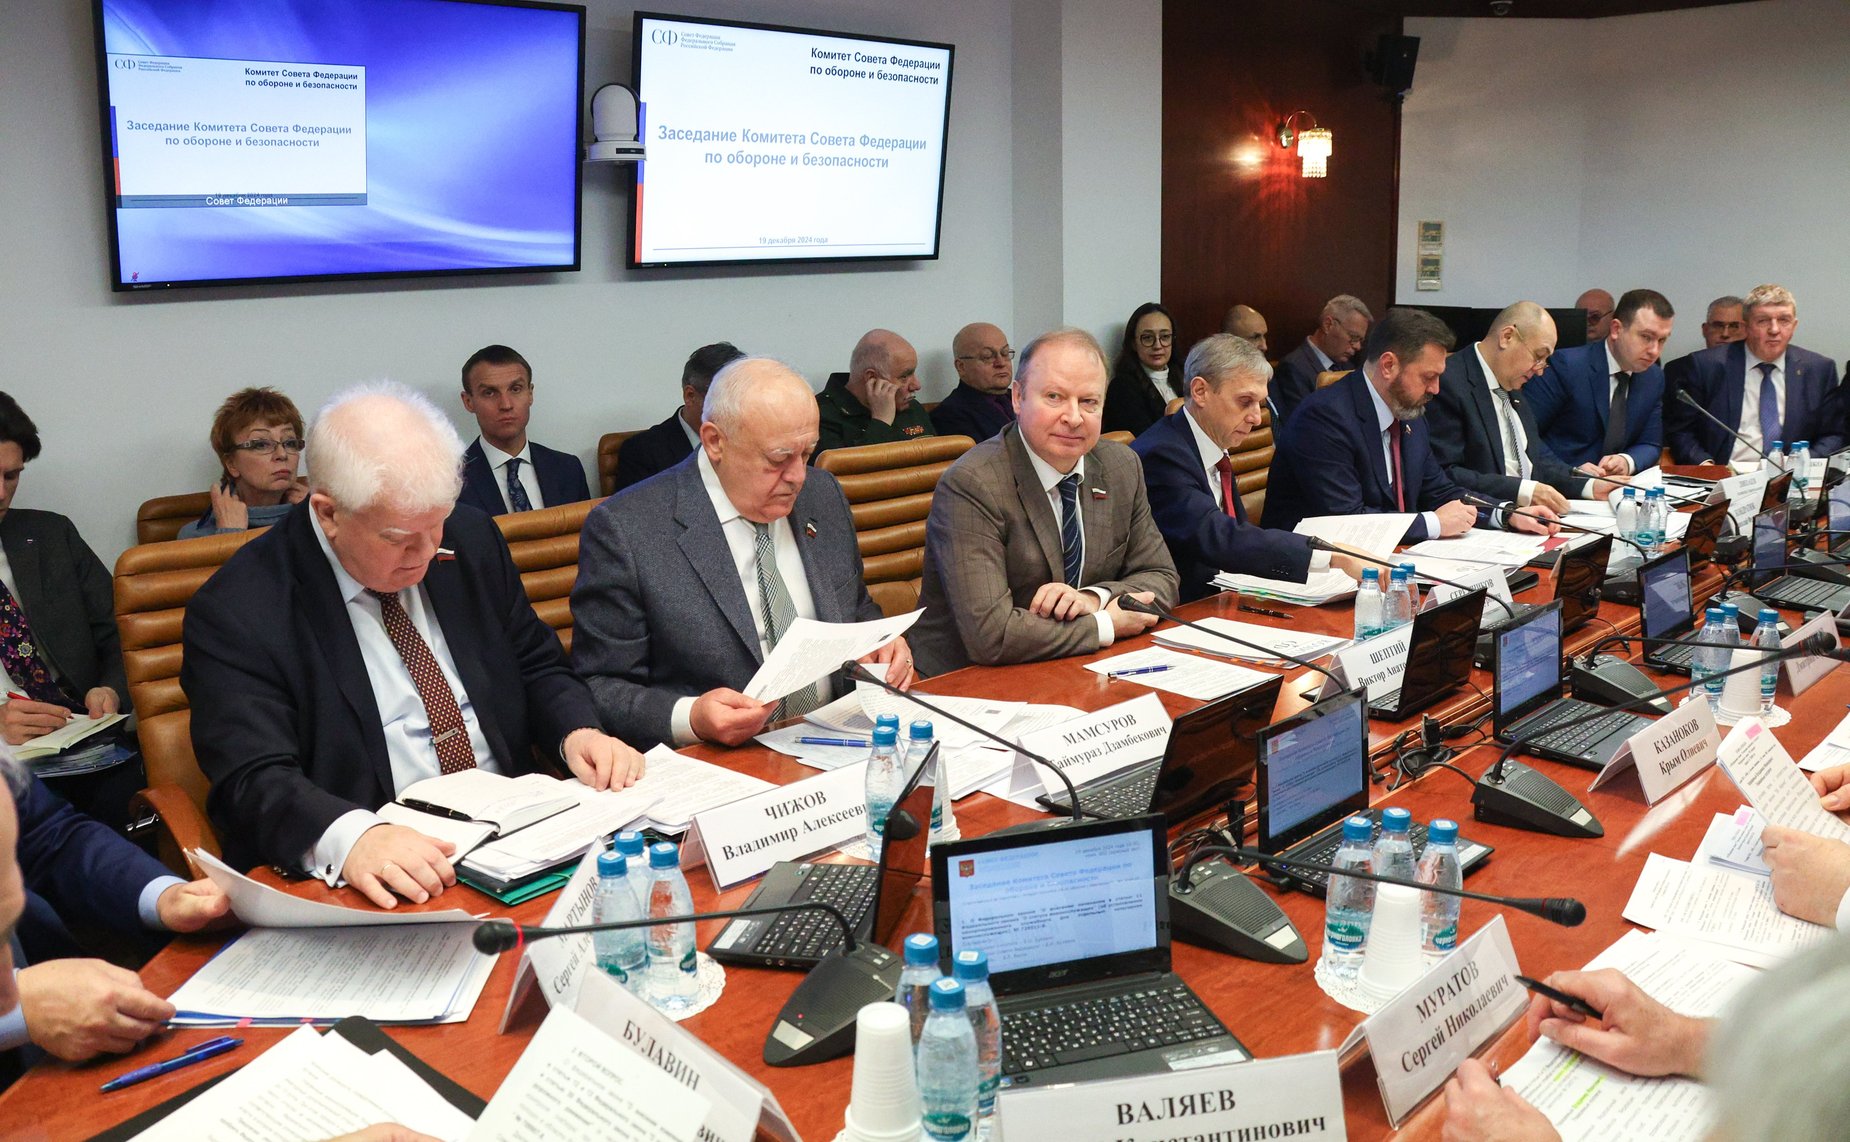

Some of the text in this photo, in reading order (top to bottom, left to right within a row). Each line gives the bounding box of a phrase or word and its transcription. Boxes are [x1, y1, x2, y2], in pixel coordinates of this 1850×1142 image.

[811, 48, 941, 71] Комитет Совета Федерации
[244, 68, 358, 81] Комитет Совета Федерации
[245, 80, 256, 88] по
[258, 80, 293, 89] обороне
[302, 81, 358, 90] безопасности
[810, 65, 938, 85] по обороне и безопасности
[126, 120, 352, 135] Заседание Комитета Совета Федерации
[658, 124, 927, 151] Заседание Комитета Совета Федерации
[165, 136, 320, 148] по обороне и безопасности
[704, 150, 889, 169] по обороне и безопасности
[206, 196, 288, 206] Совет Федерации
[759, 236, 766, 244] 19
[768, 236, 795, 245] декабря
[797, 236, 812, 244] 2024
[1369, 640, 1406, 664] ШЕПТИЙ
[1358, 670, 1386, 688] Виктор
[1062, 714, 1137, 747] МАМСУРОВ
[1104, 725, 1167, 755] Дзамбекович
[1653, 718, 1700, 754] КАЗАНОКОВ
[1659, 756, 1682, 776] Крым
[1680, 738, 1708, 762] Олиевич
[764, 790, 827, 820] ЧИЖОВ
[722, 826, 798, 862] Владимир
[554, 950, 579, 994] Сергей
[1415, 960, 1479, 1023] МУРАТОВ
[1402, 975, 1509, 1073] Сергей Николаевич
[622, 1020, 700, 1091] БУЛАВИН
[1116, 1089, 1236, 1126] ВАЛЯЕВ
[1116, 1116, 1326, 1142] антинович
